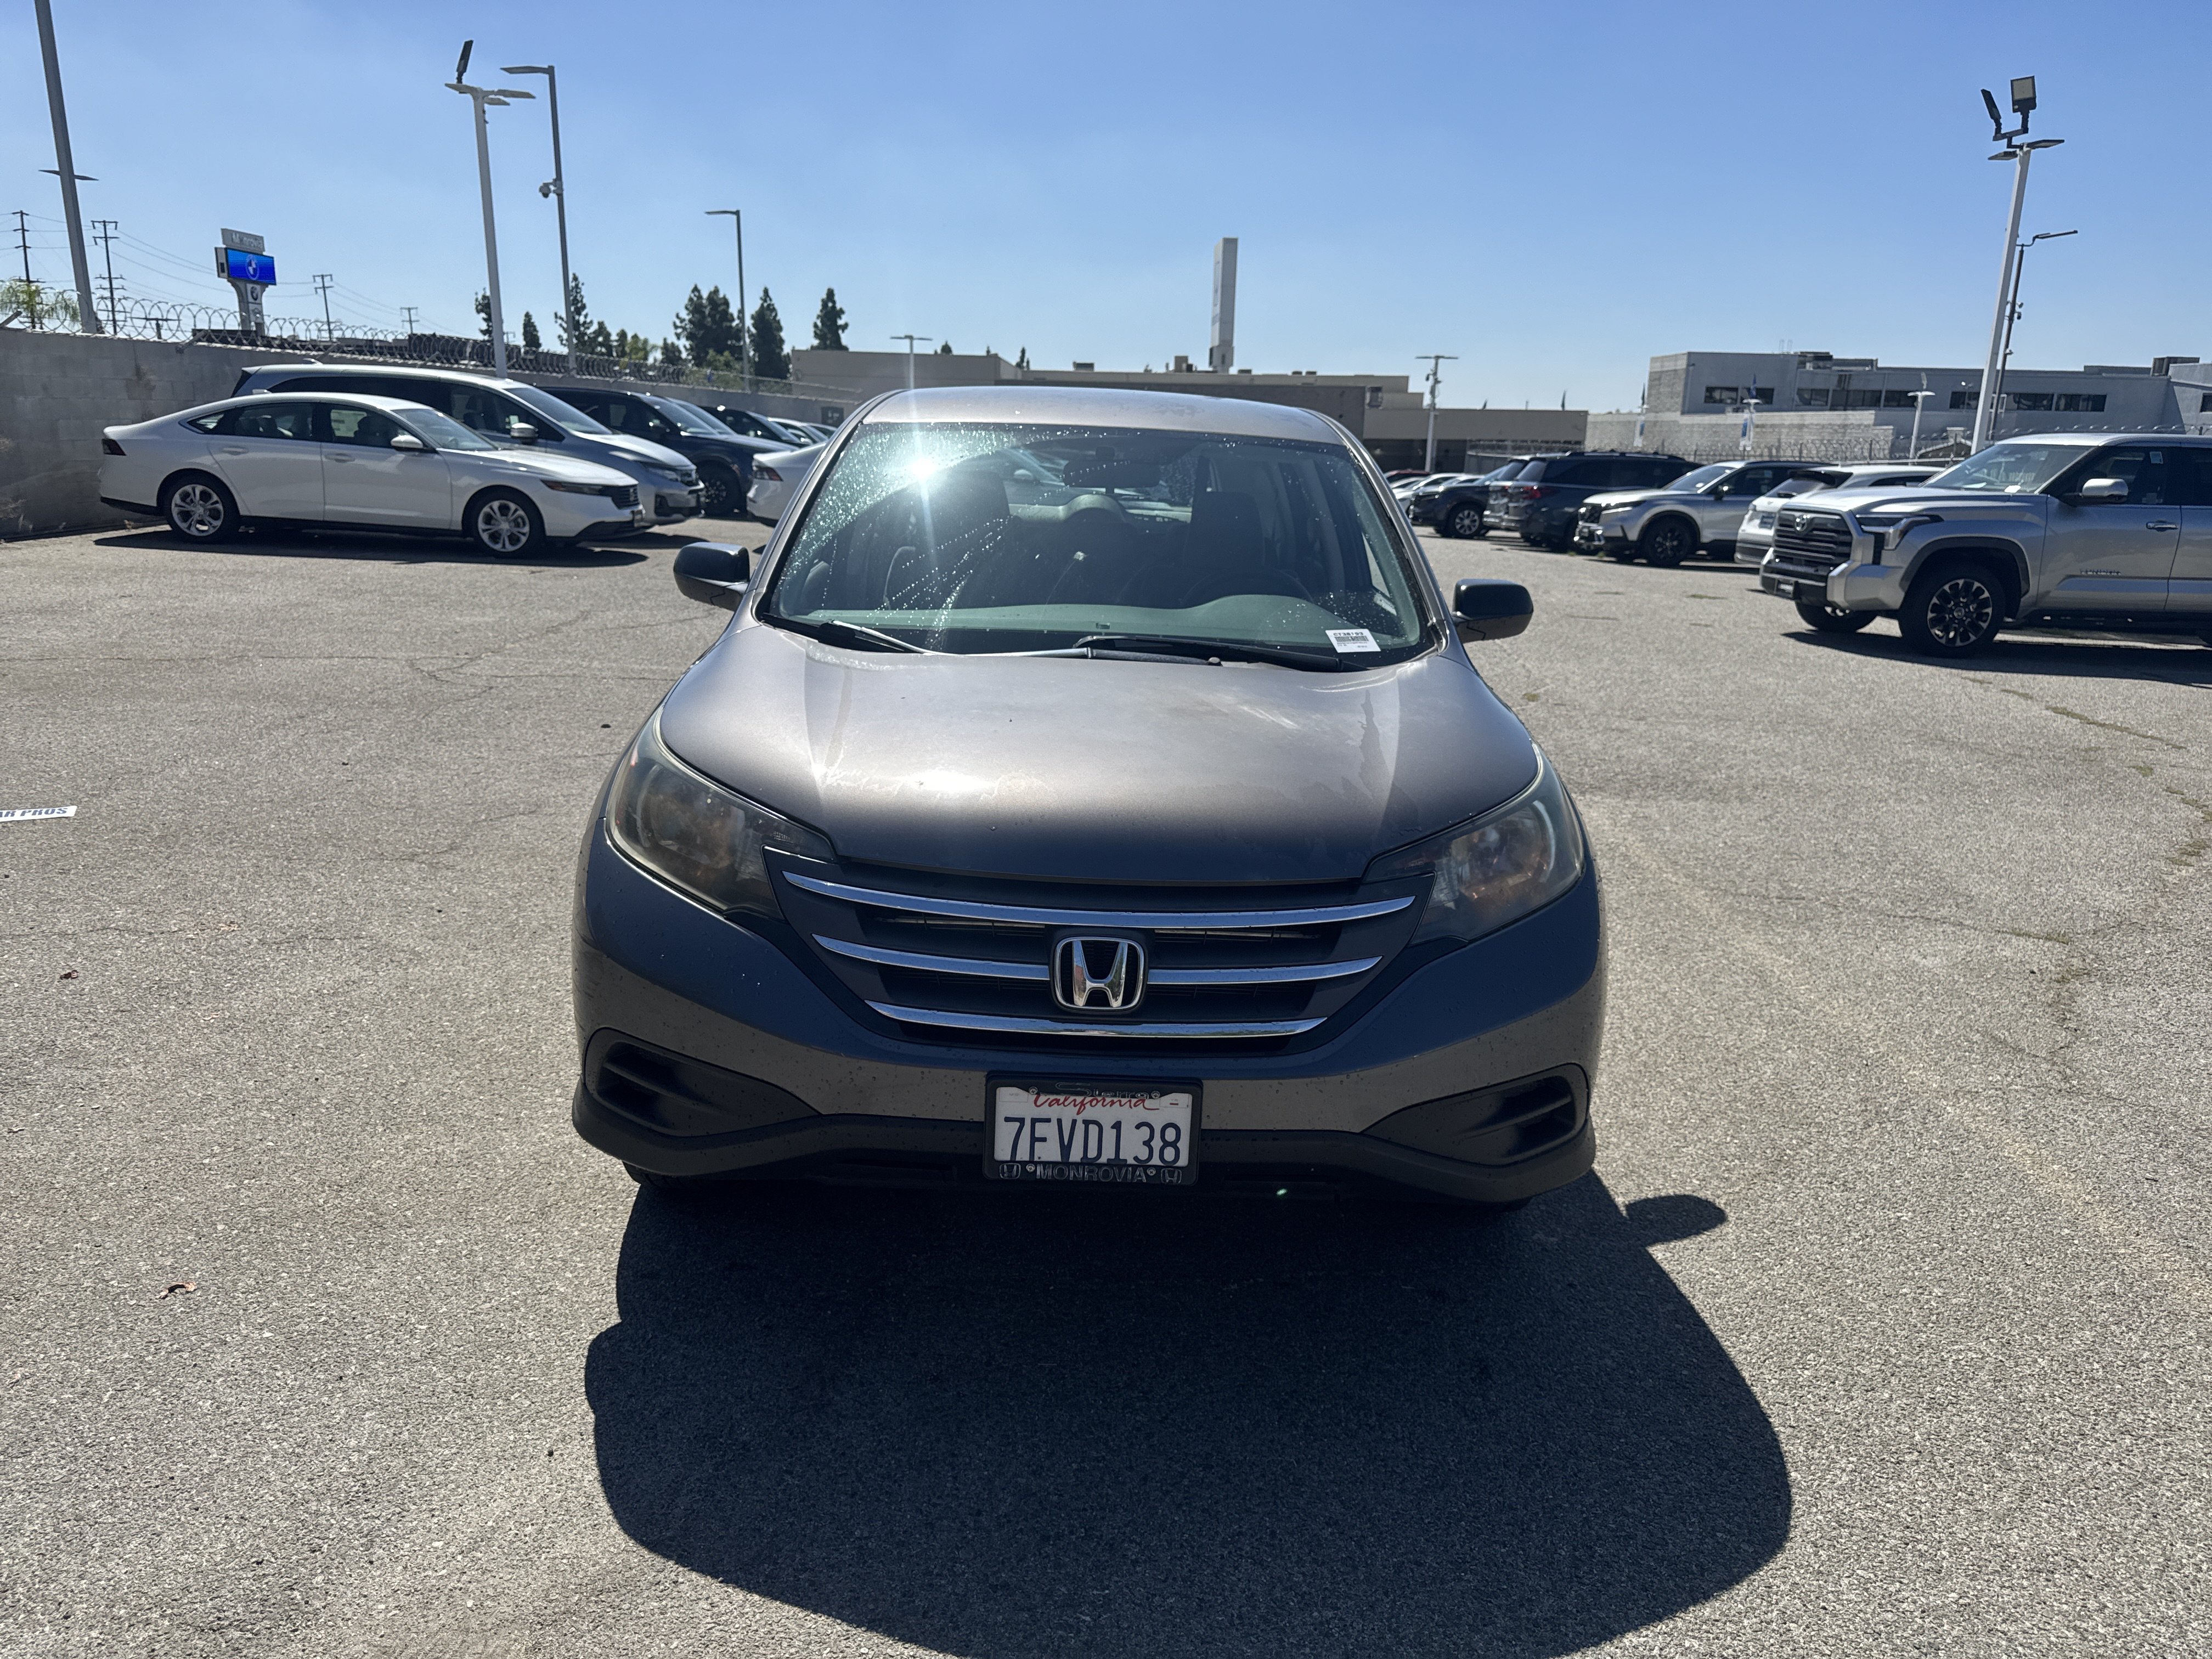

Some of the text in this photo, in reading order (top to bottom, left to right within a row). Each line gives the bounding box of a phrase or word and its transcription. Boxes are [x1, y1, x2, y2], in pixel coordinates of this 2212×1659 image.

[20, 808, 68, 816] PROS
[1034, 1094, 1160, 1115] California
[1004, 1116, 1181, 1166] 7FVD138
[1036, 1164, 1147, 1183] MONROVIA
